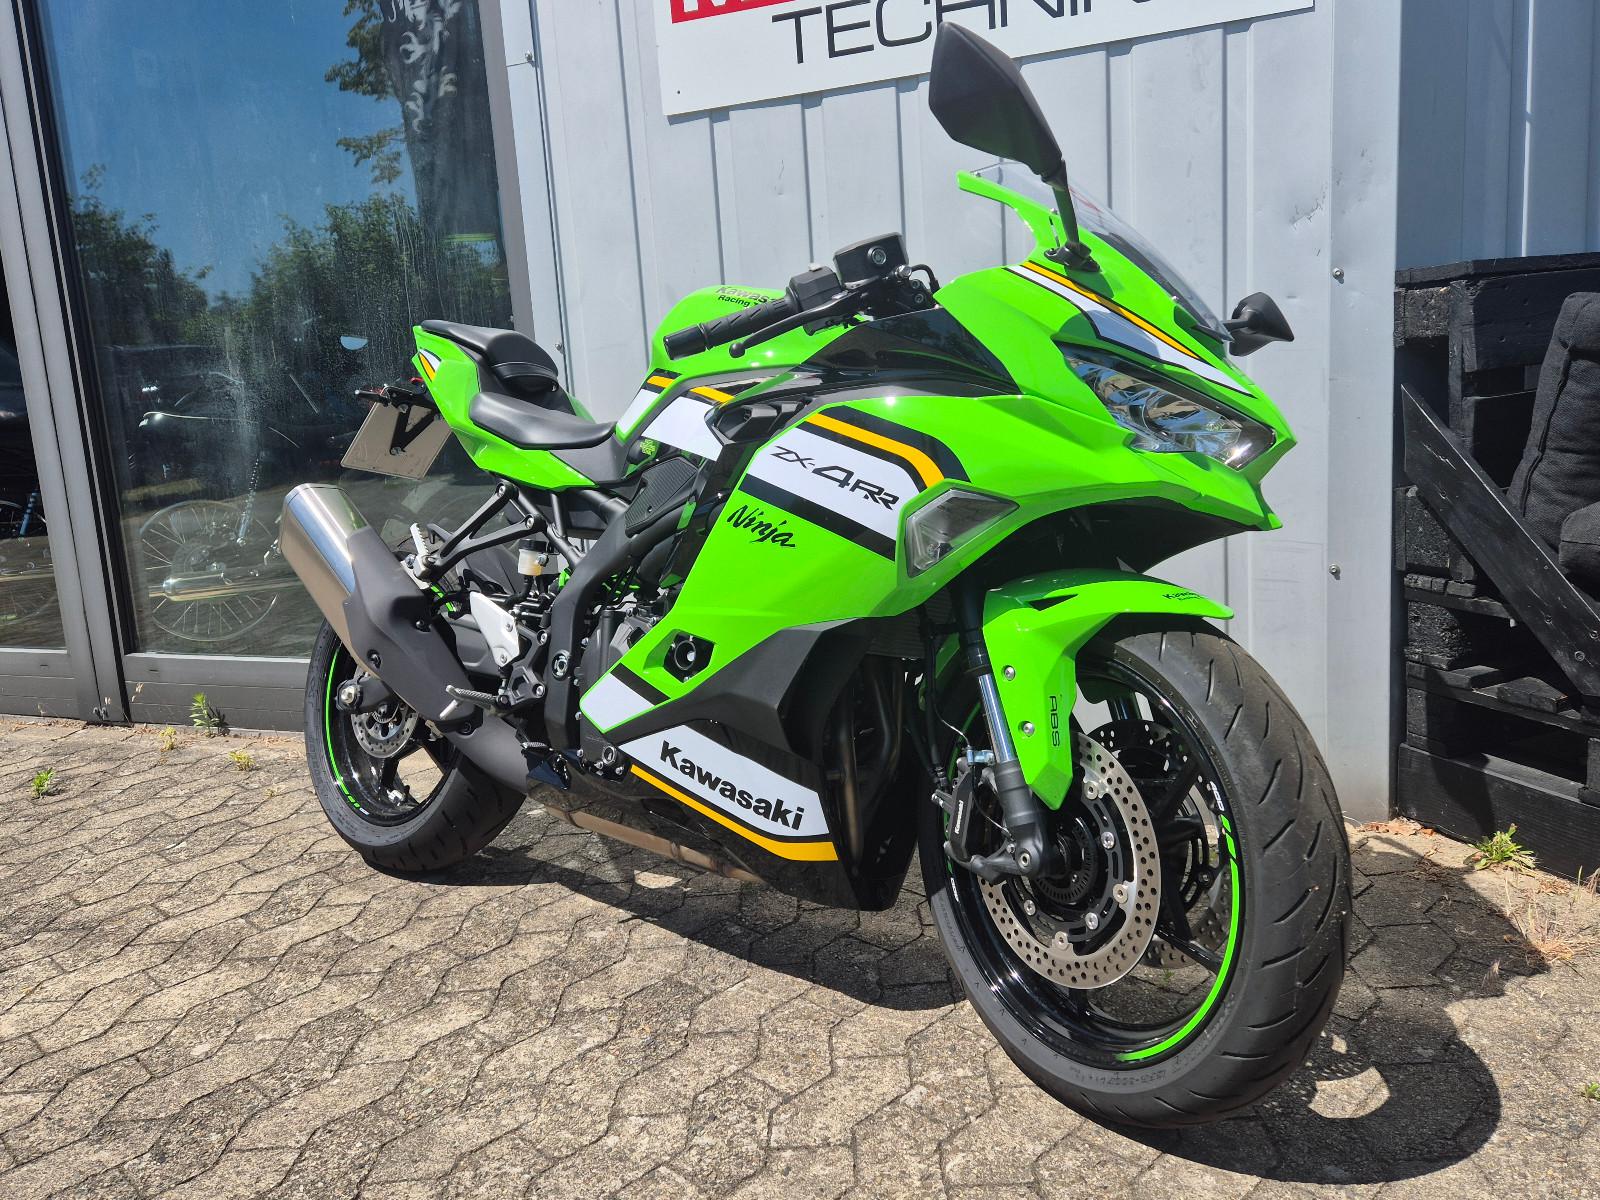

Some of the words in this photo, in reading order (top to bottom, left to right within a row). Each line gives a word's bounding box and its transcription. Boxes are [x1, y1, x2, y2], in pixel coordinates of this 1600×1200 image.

[772, 0, 1152, 65] TECH
[718, 295, 751, 308] Racing
[770, 445, 900, 511] ZX-4RR
[726, 504, 796, 548] Ninja
[1049, 694, 1061, 748] ABS
[659, 740, 805, 831] Kawasaki
